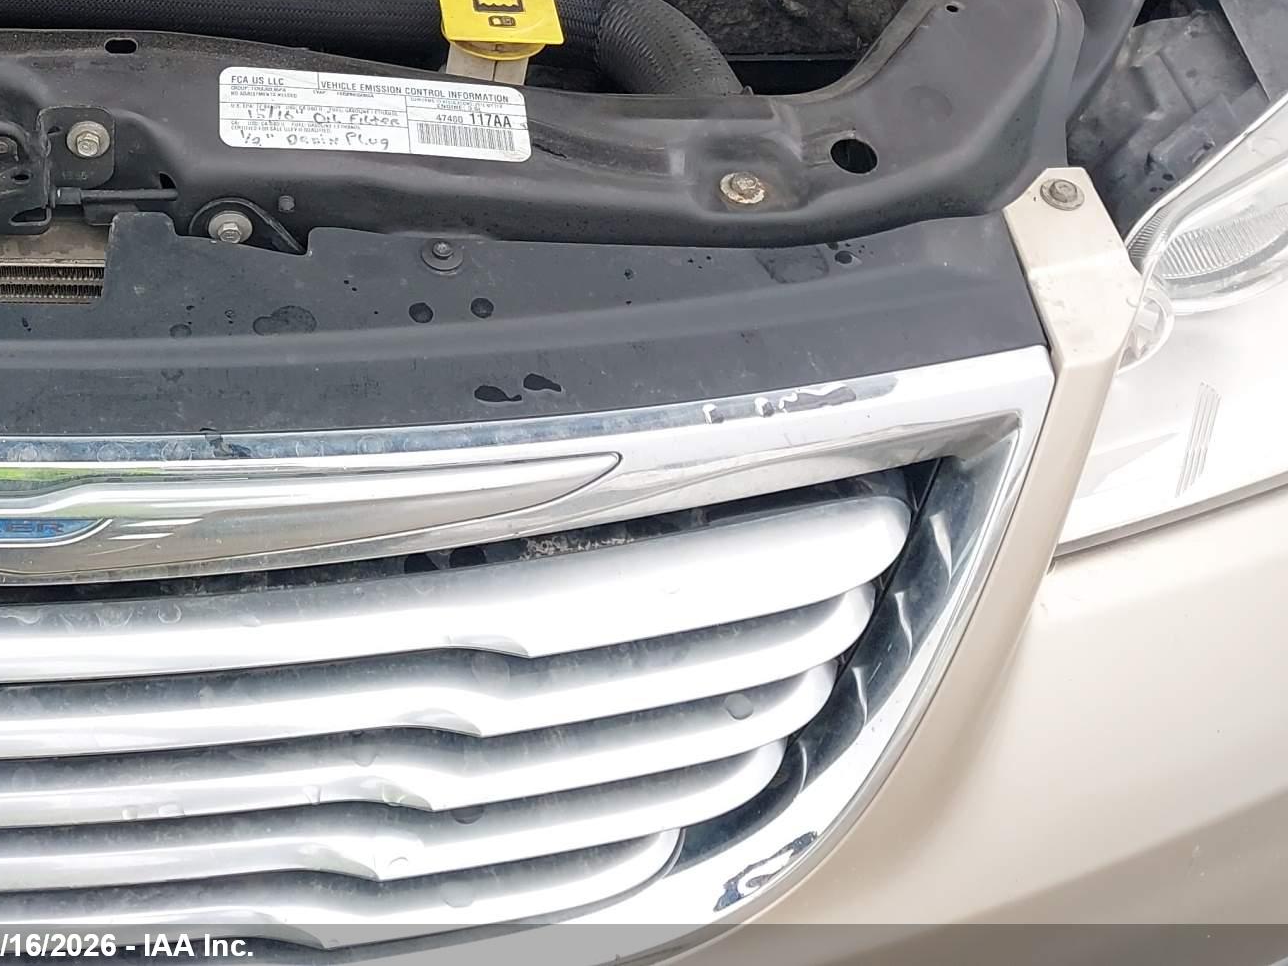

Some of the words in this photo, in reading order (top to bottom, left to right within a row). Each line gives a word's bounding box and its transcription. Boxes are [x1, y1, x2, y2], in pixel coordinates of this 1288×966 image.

[231, 75, 249, 84] FCA
[252, 76, 265, 85] US
[267, 77, 285, 86] LLC
[321, 81, 358, 91] VEHICLE
[360, 83, 402, 94] EMISSION
[404, 87, 446, 98] CONTROL
[448, 90, 509, 103] INFORMATION
[469, 113, 512, 128] 117AA
